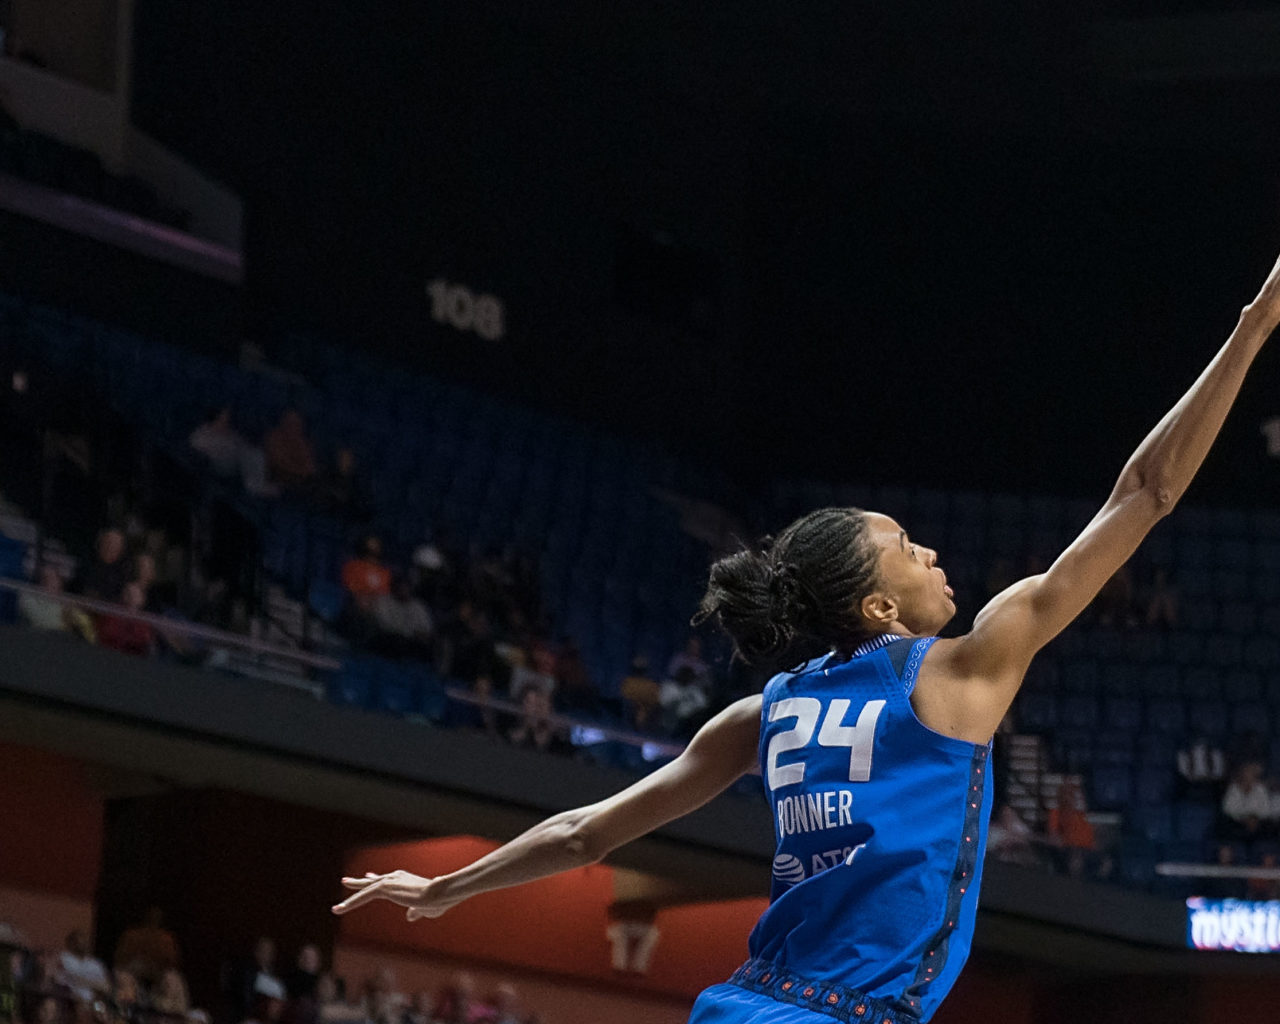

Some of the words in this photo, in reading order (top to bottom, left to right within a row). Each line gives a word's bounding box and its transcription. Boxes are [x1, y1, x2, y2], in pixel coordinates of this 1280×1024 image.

[427, 280, 504, 340] 108
[767, 697, 887, 791] 24
[777, 790, 853, 838] BONNER
